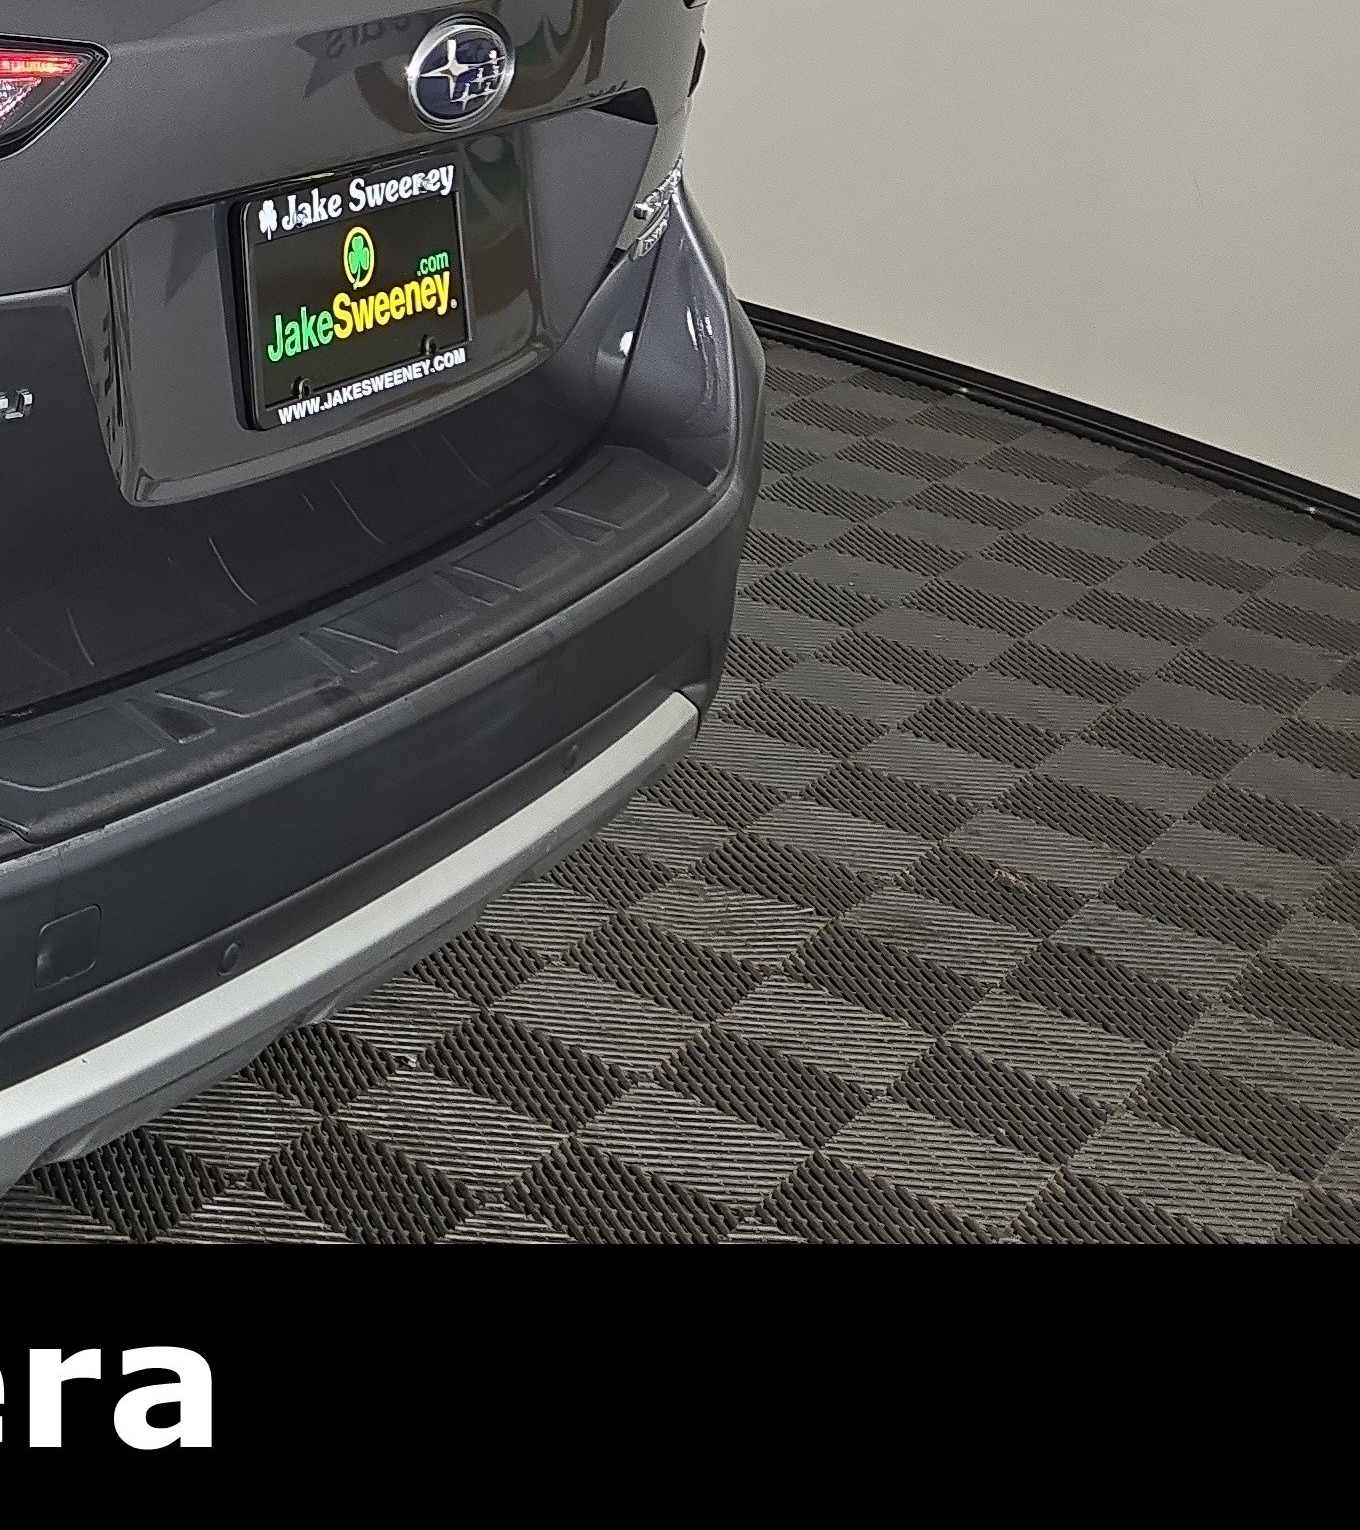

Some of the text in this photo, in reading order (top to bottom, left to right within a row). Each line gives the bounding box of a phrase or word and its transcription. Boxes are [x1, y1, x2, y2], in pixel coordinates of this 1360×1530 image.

[281, 164, 455, 232] Jake Sweeney
[416, 251, 450, 277] .com
[278, 346, 467, 425] WWW.JAKESWEENEY.COM
